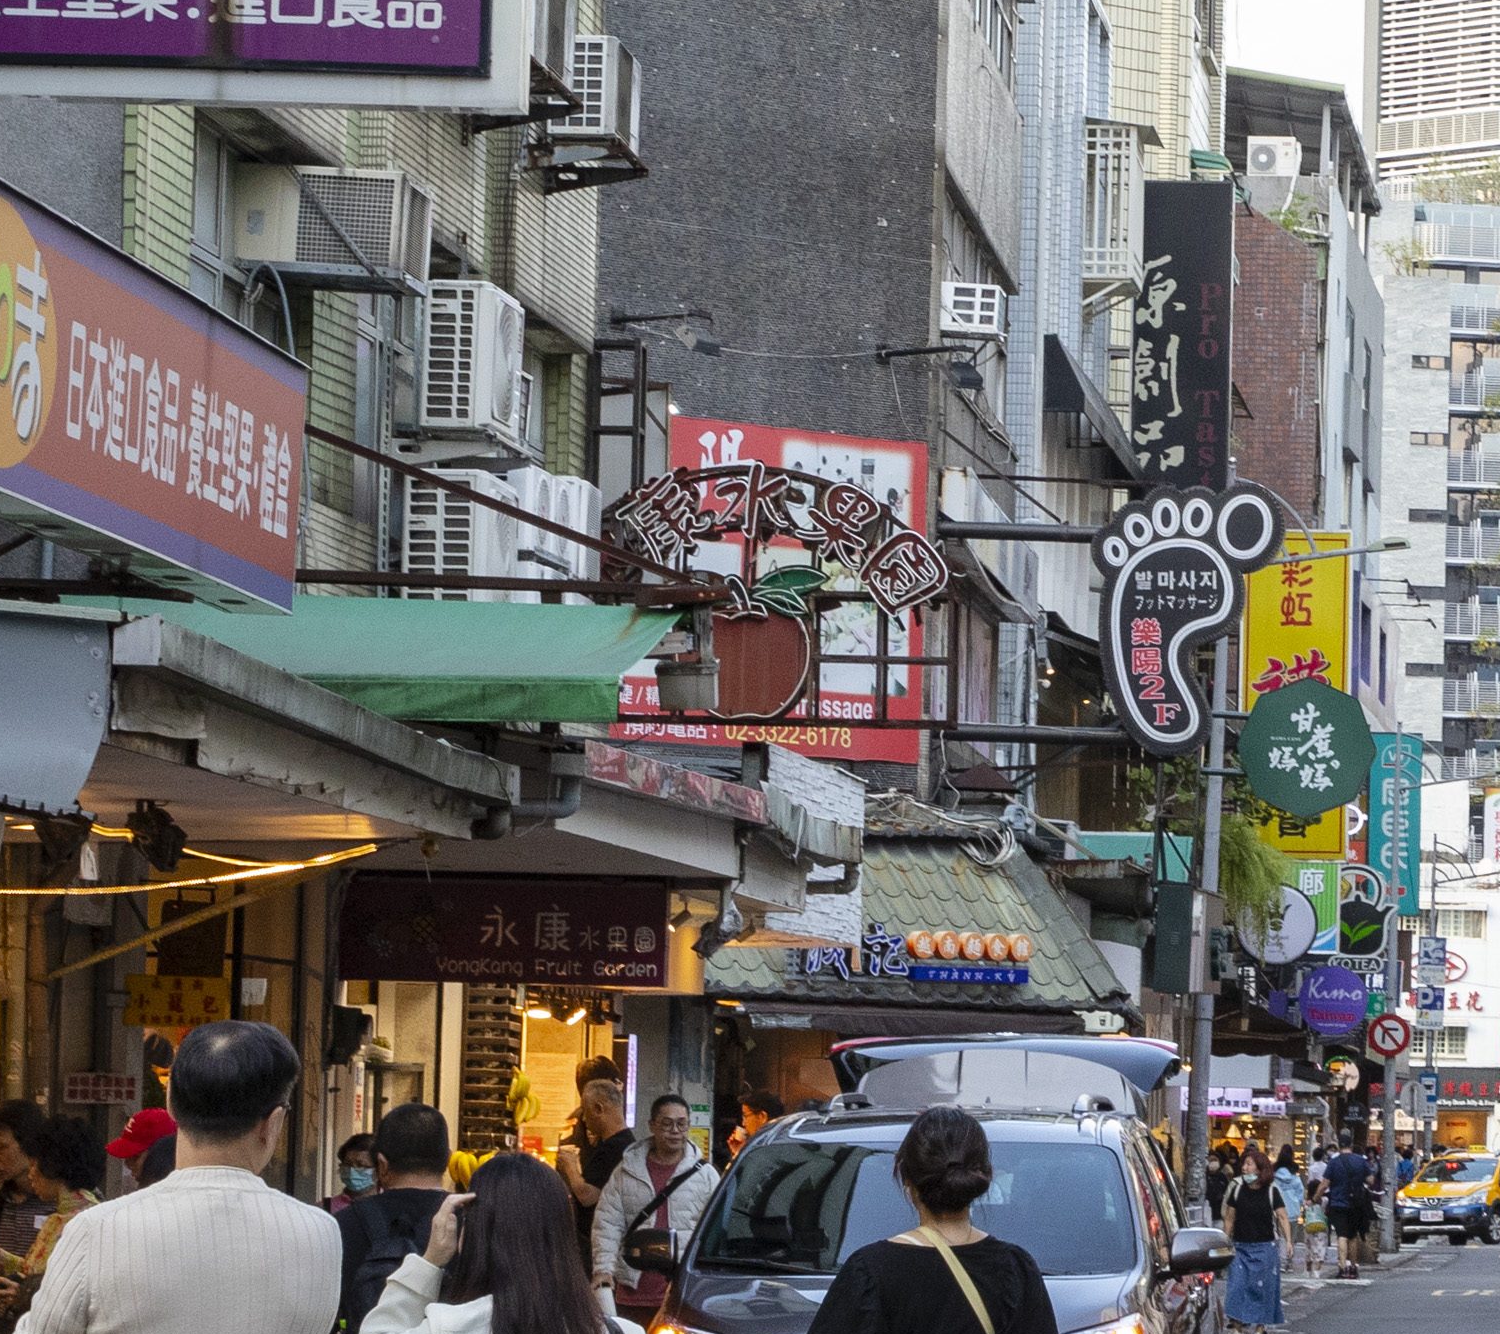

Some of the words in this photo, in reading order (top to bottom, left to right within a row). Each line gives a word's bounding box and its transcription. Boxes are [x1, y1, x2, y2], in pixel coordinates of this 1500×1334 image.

[1134, 570, 1218, 591] 발마사지
[435, 955, 523, 979] YongKang
[535, 955, 580, 977] Fruit
[593, 956, 657, 979] Garden
[1354, 959, 1378, 971] TEA
